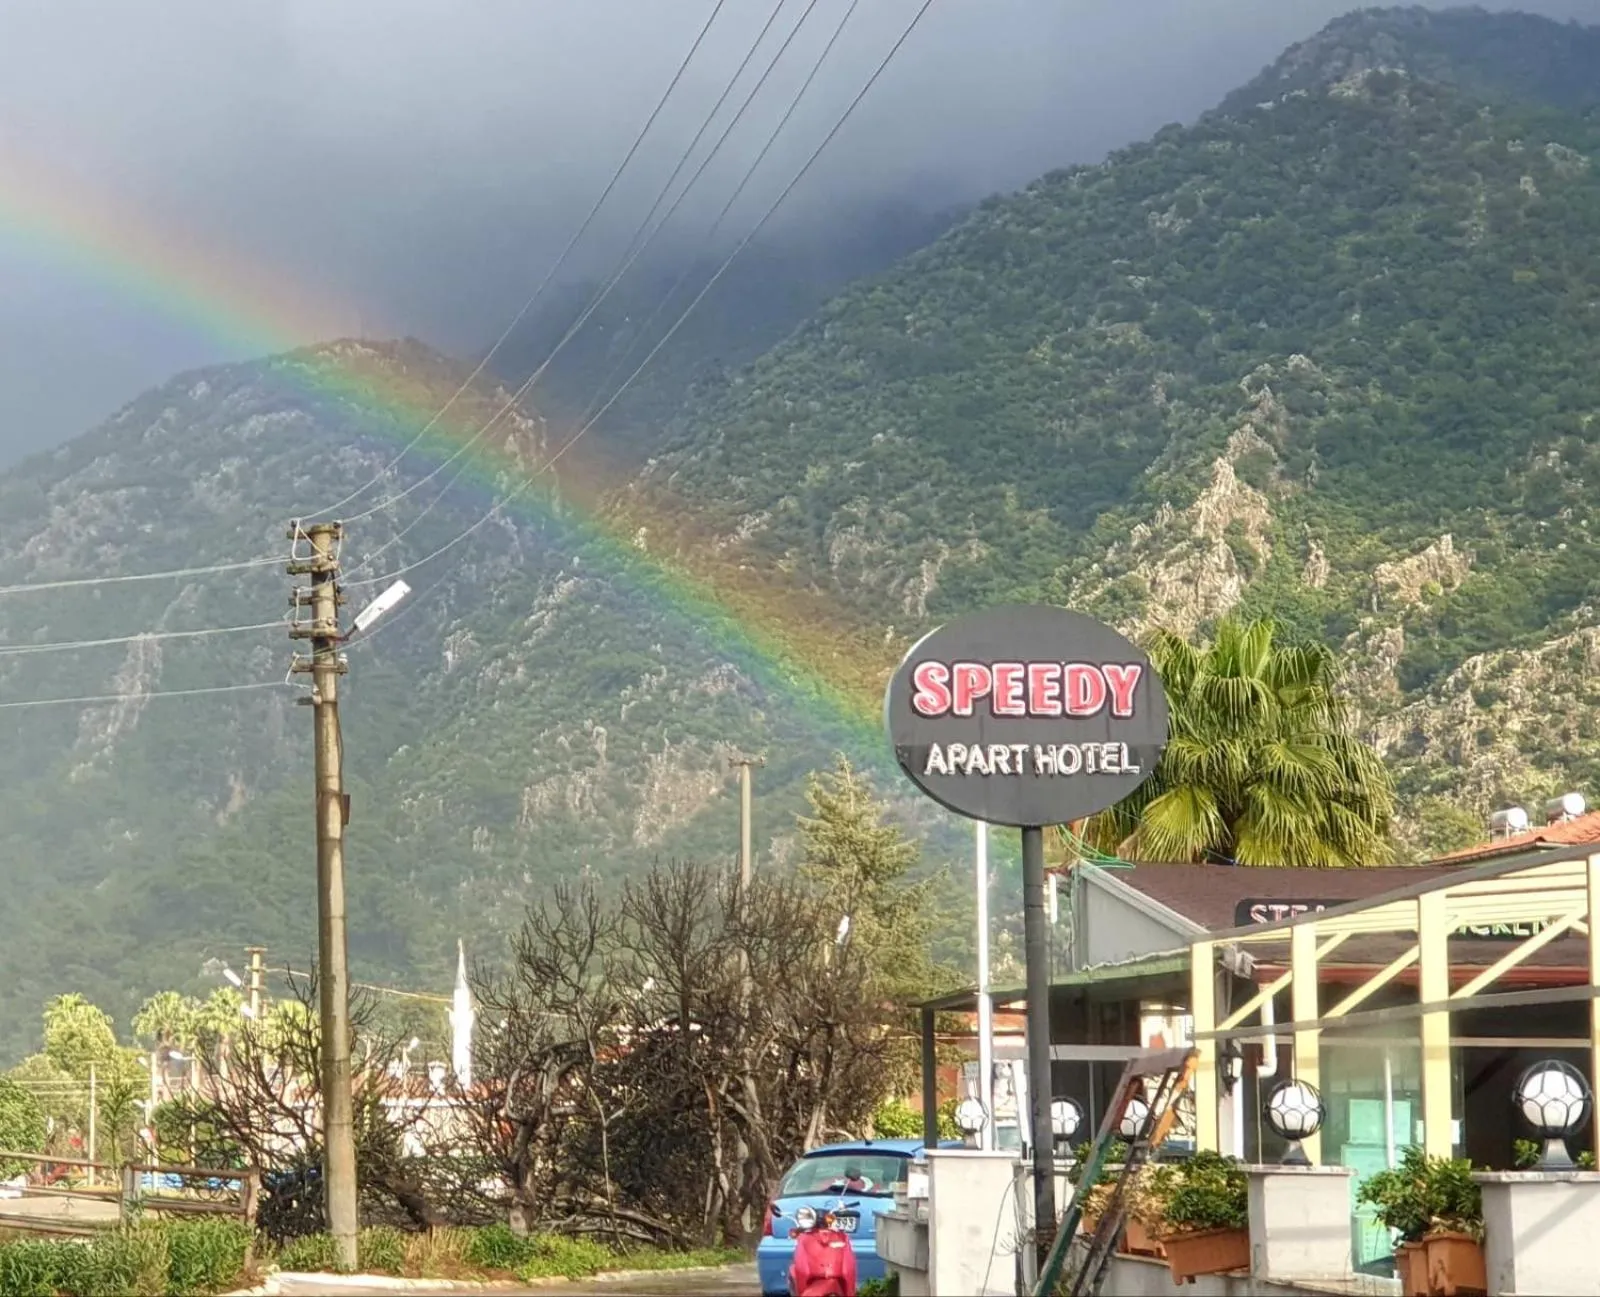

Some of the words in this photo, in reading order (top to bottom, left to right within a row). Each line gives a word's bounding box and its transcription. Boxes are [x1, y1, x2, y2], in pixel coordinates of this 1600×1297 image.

[912, 660, 1142, 717] SPEEDY
[923, 742, 1029, 775] APART
[1034, 742, 1140, 775] HOTEL
